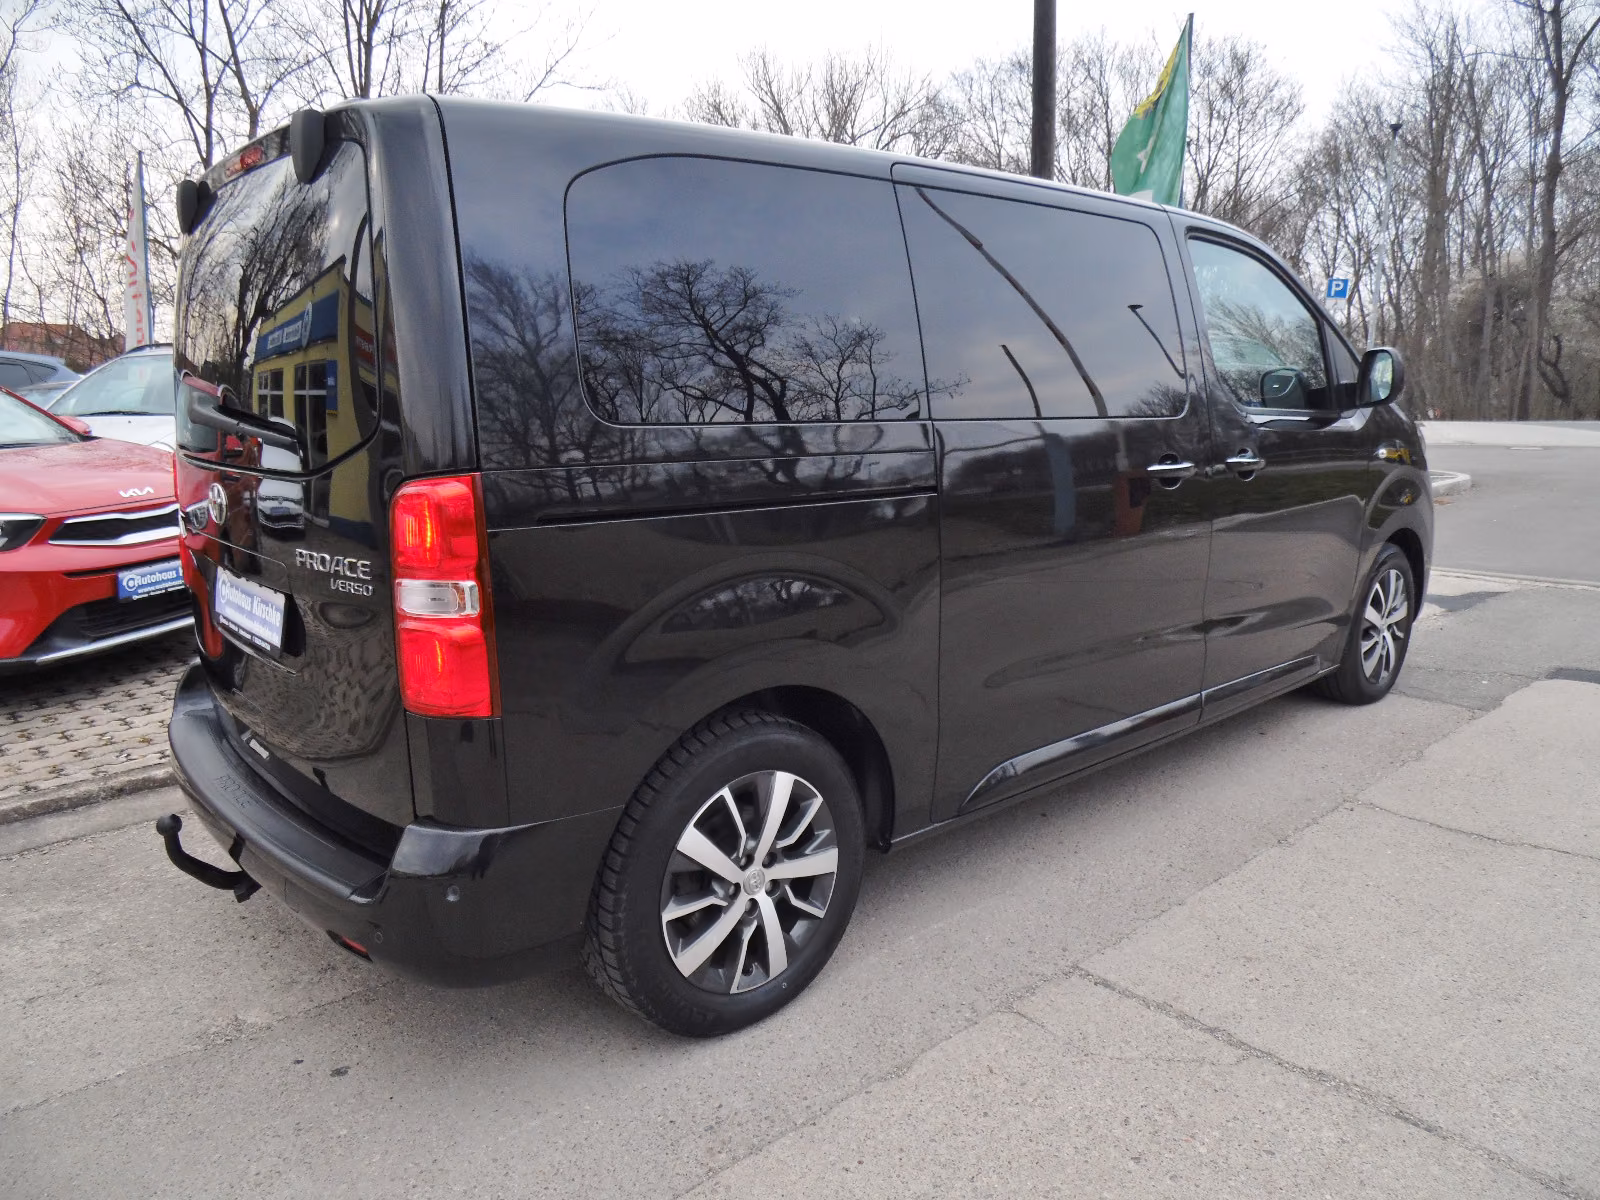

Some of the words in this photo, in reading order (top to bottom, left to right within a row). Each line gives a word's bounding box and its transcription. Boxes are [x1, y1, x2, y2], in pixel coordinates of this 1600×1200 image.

[1331, 280, 1344, 297] P
[295, 548, 372, 580] PROACE
[135, 570, 177, 586] Autohaus
[330, 577, 373, 597] VERSO
[252, 595, 281, 627] Kirschke
